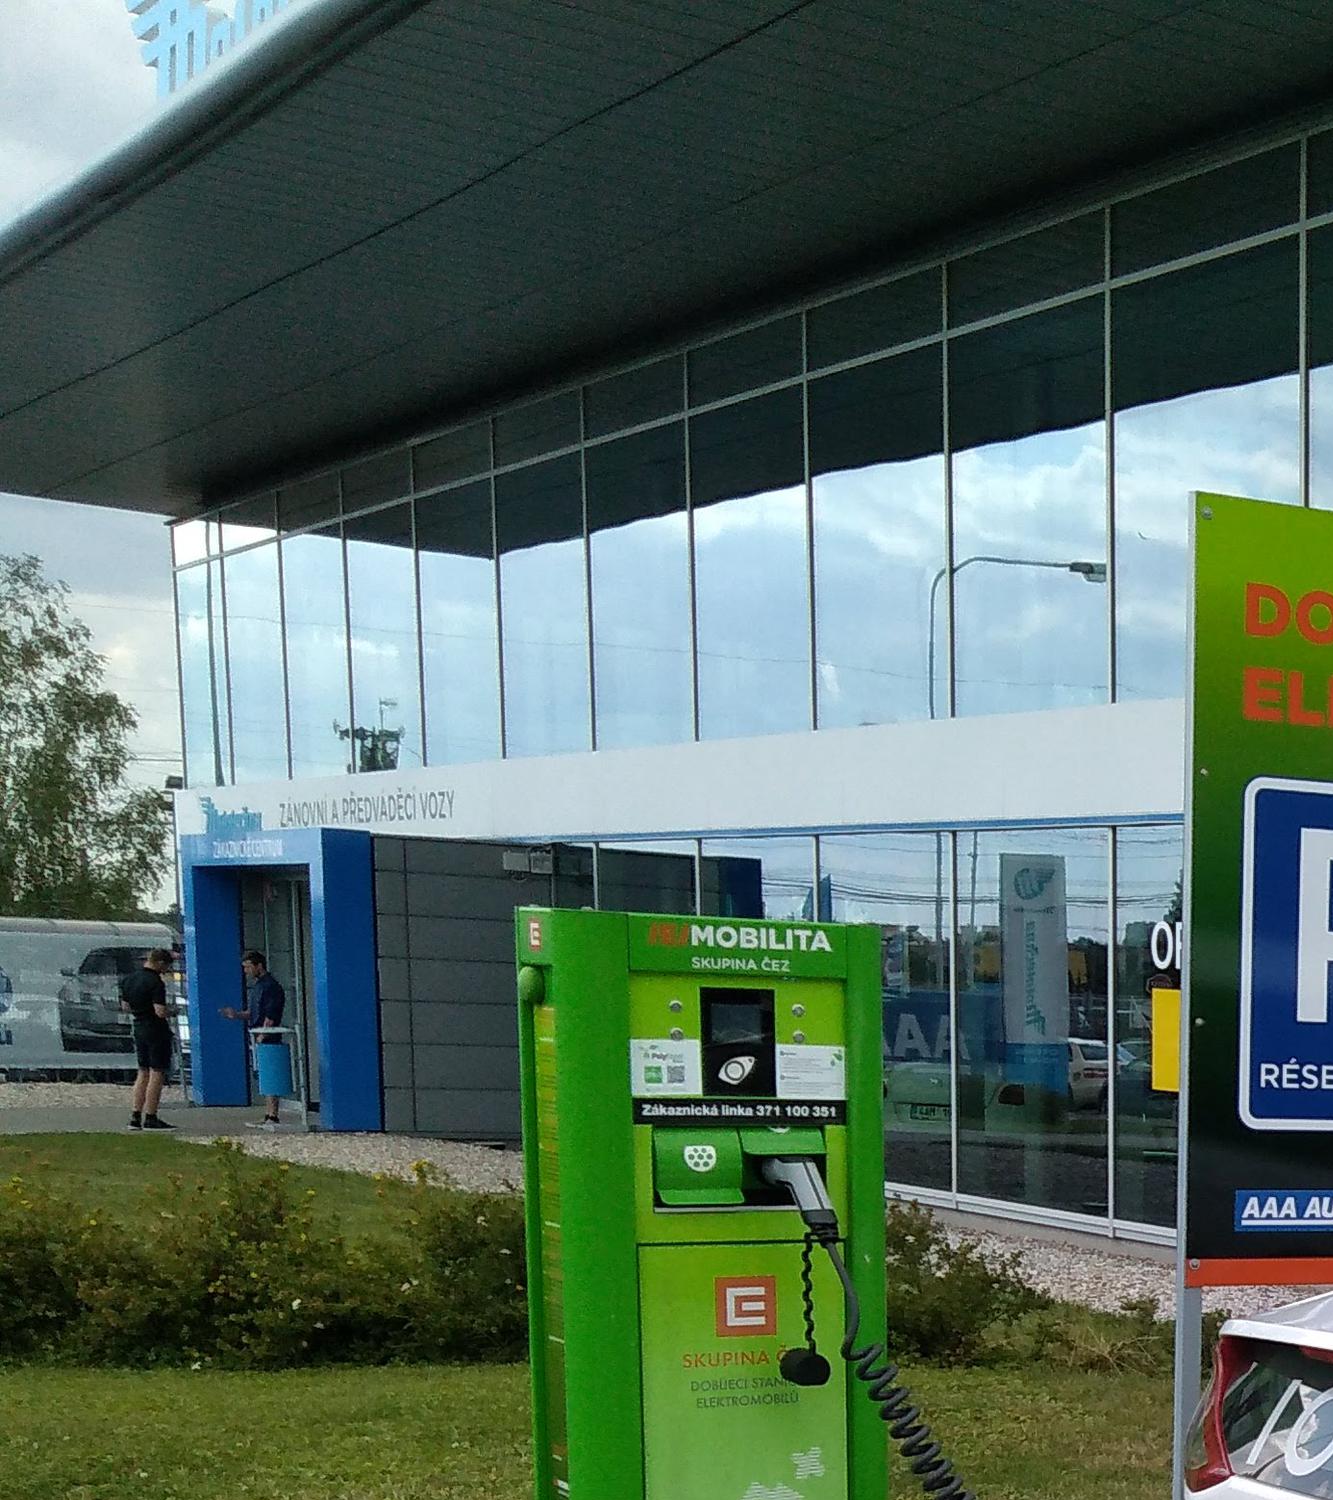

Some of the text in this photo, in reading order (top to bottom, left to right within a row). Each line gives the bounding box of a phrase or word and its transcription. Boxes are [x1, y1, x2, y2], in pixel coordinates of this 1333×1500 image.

[279, 796, 327, 827] ZÁNOVNÍ
[331, 803, 340, 826] A
[421, 790, 455, 820] VOZY
[691, 956, 791, 973] SKUPINA ČEZ
[642, 1102, 837, 1118] Zákaznická linka 371 100 351
[1242, 1195, 1299, 1220] AAA
[682, 1350, 770, 1369] SKUPINA
